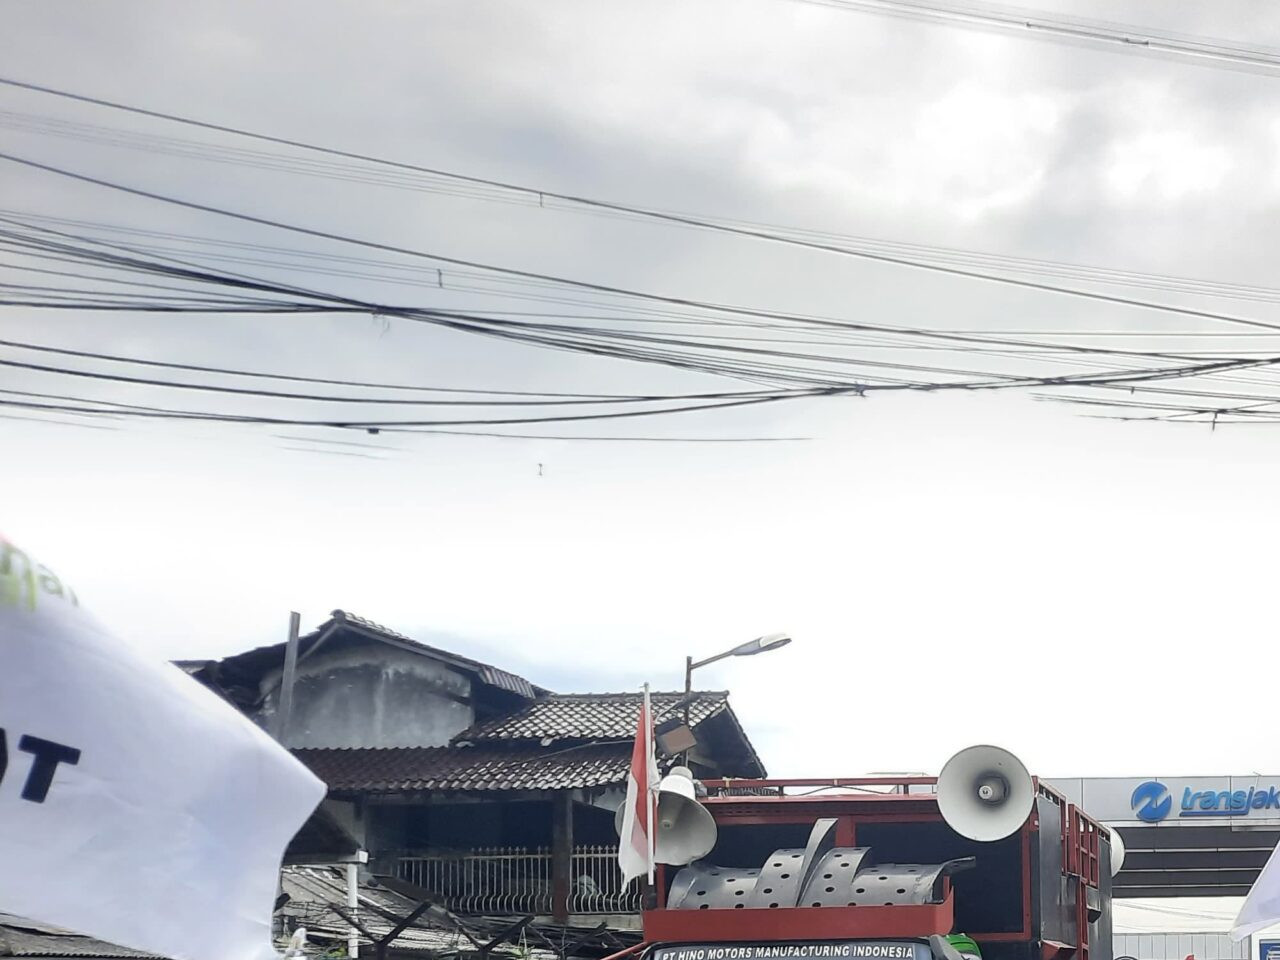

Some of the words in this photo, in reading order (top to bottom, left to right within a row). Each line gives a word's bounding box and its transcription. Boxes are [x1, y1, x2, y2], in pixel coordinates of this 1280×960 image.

[707, 948, 752, 960] MOTORS
[755, 945, 850, 959] MANUFACTURING
[853, 945, 914, 959] INDONESIA
